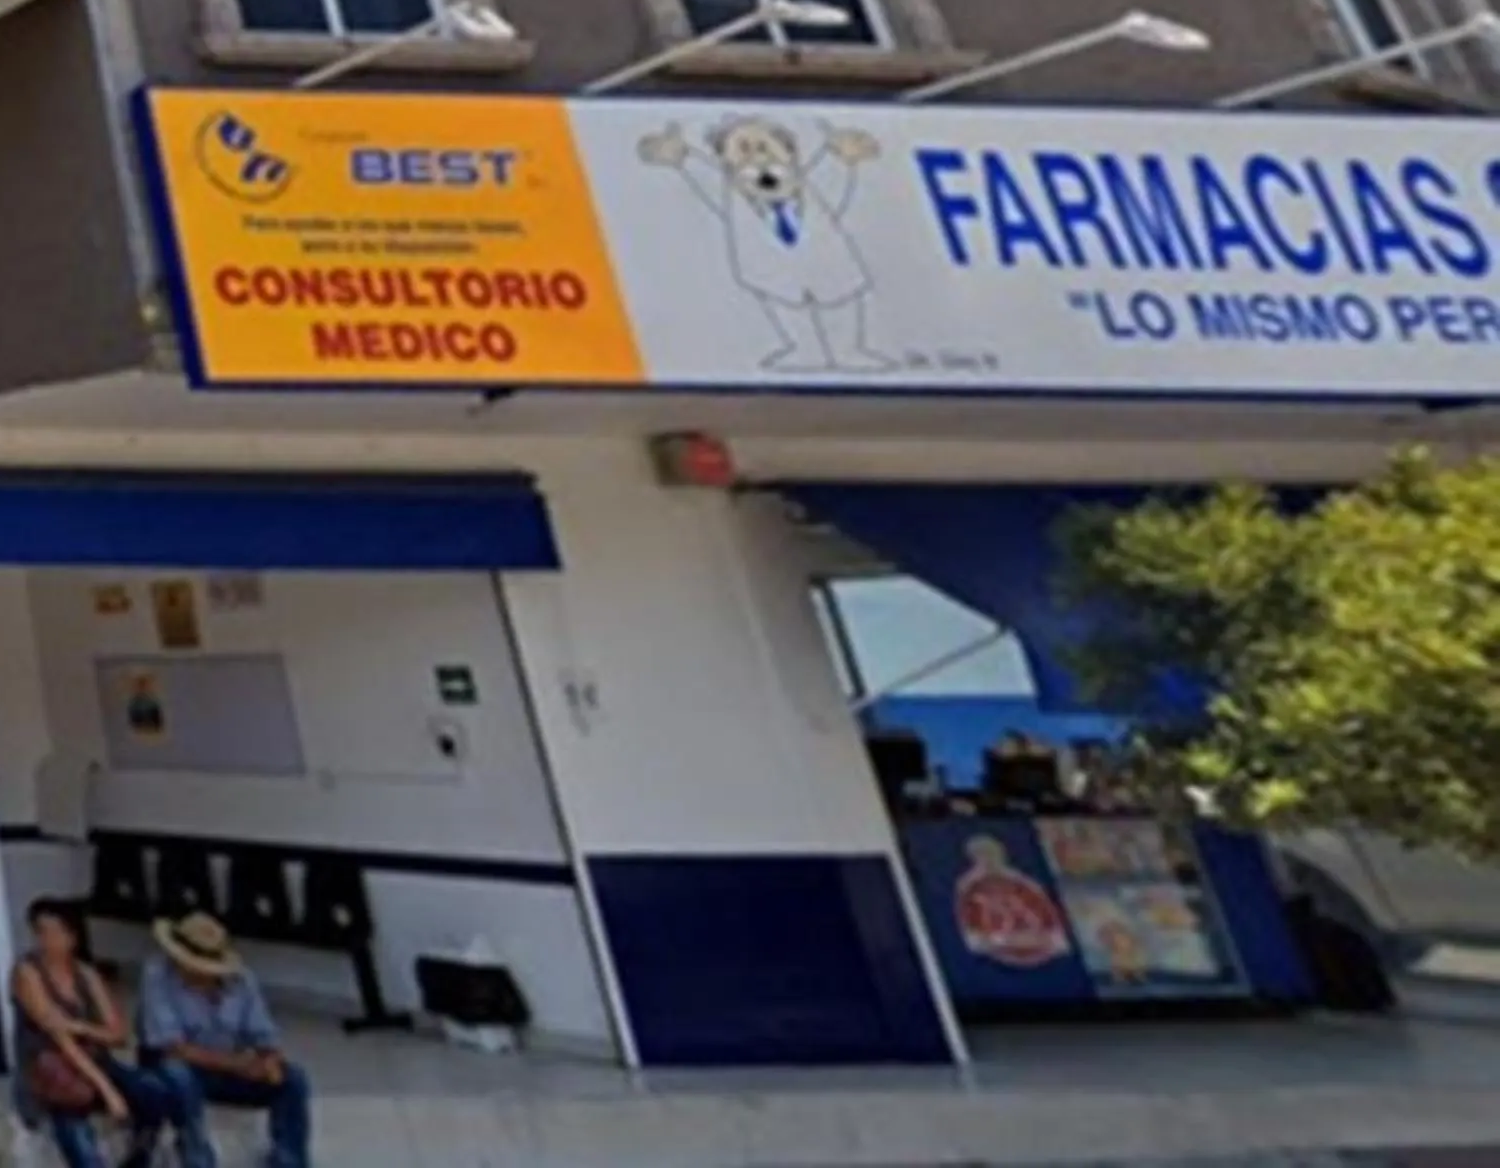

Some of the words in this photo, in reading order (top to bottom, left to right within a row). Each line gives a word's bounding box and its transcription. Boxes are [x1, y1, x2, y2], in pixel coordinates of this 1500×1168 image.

[351, 149, 515, 186] BEST
[915, 149, 1490, 277] FARMACIAS
[213, 266, 588, 310] CONSULTORIO
[1189, 293, 1379, 342] MISMO
[312, 321, 516, 364] MEDICO
